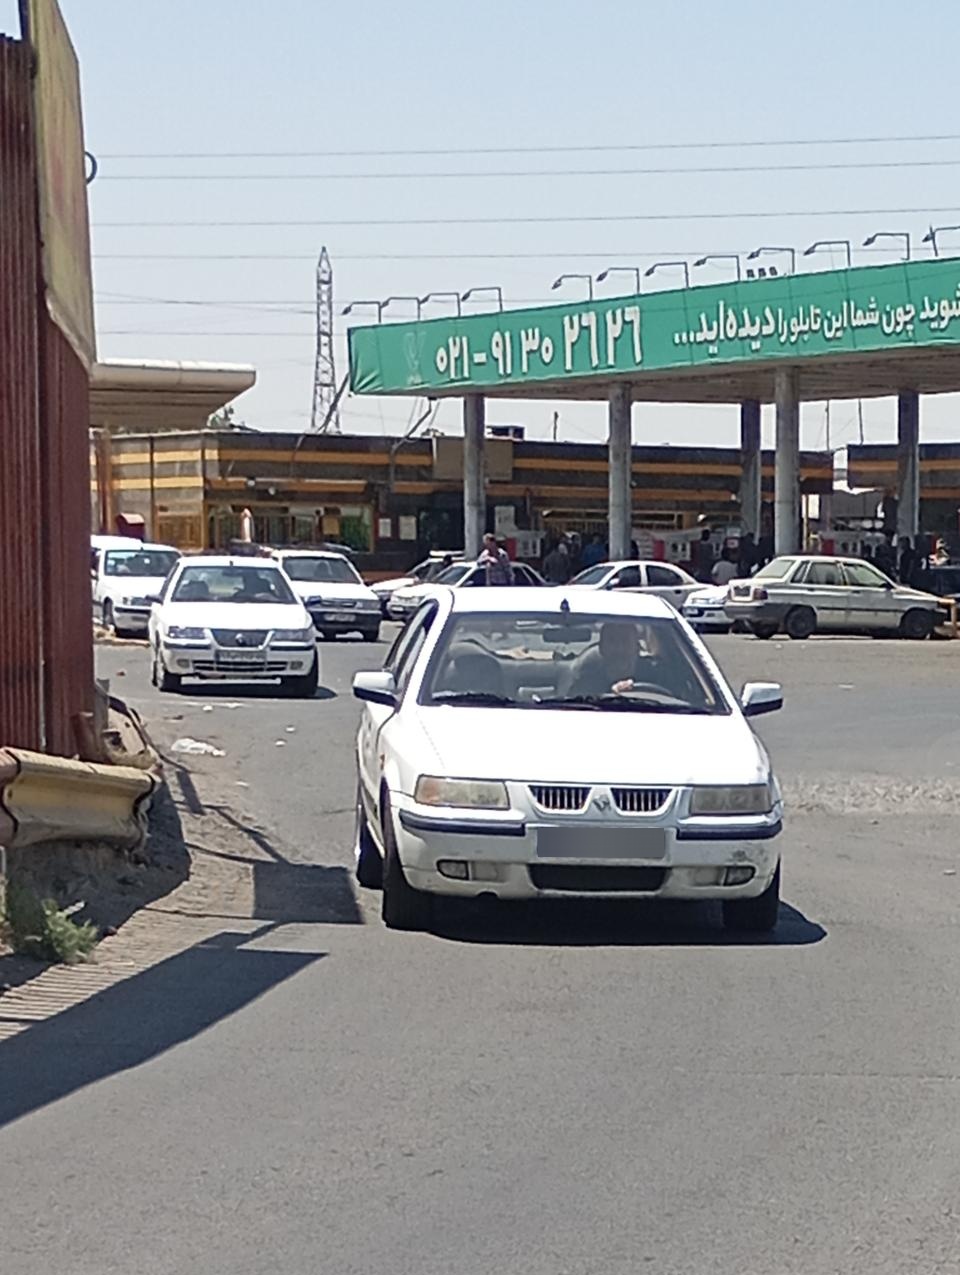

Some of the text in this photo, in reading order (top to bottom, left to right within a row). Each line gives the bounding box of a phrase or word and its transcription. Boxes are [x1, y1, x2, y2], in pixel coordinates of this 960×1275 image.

[777, 308, 787, 343] را
[789, 304, 821, 342] تابلو
[823, 300, 848, 338] این
[850, 296, 880, 327] شما
[881, 303, 915, 337] چون
